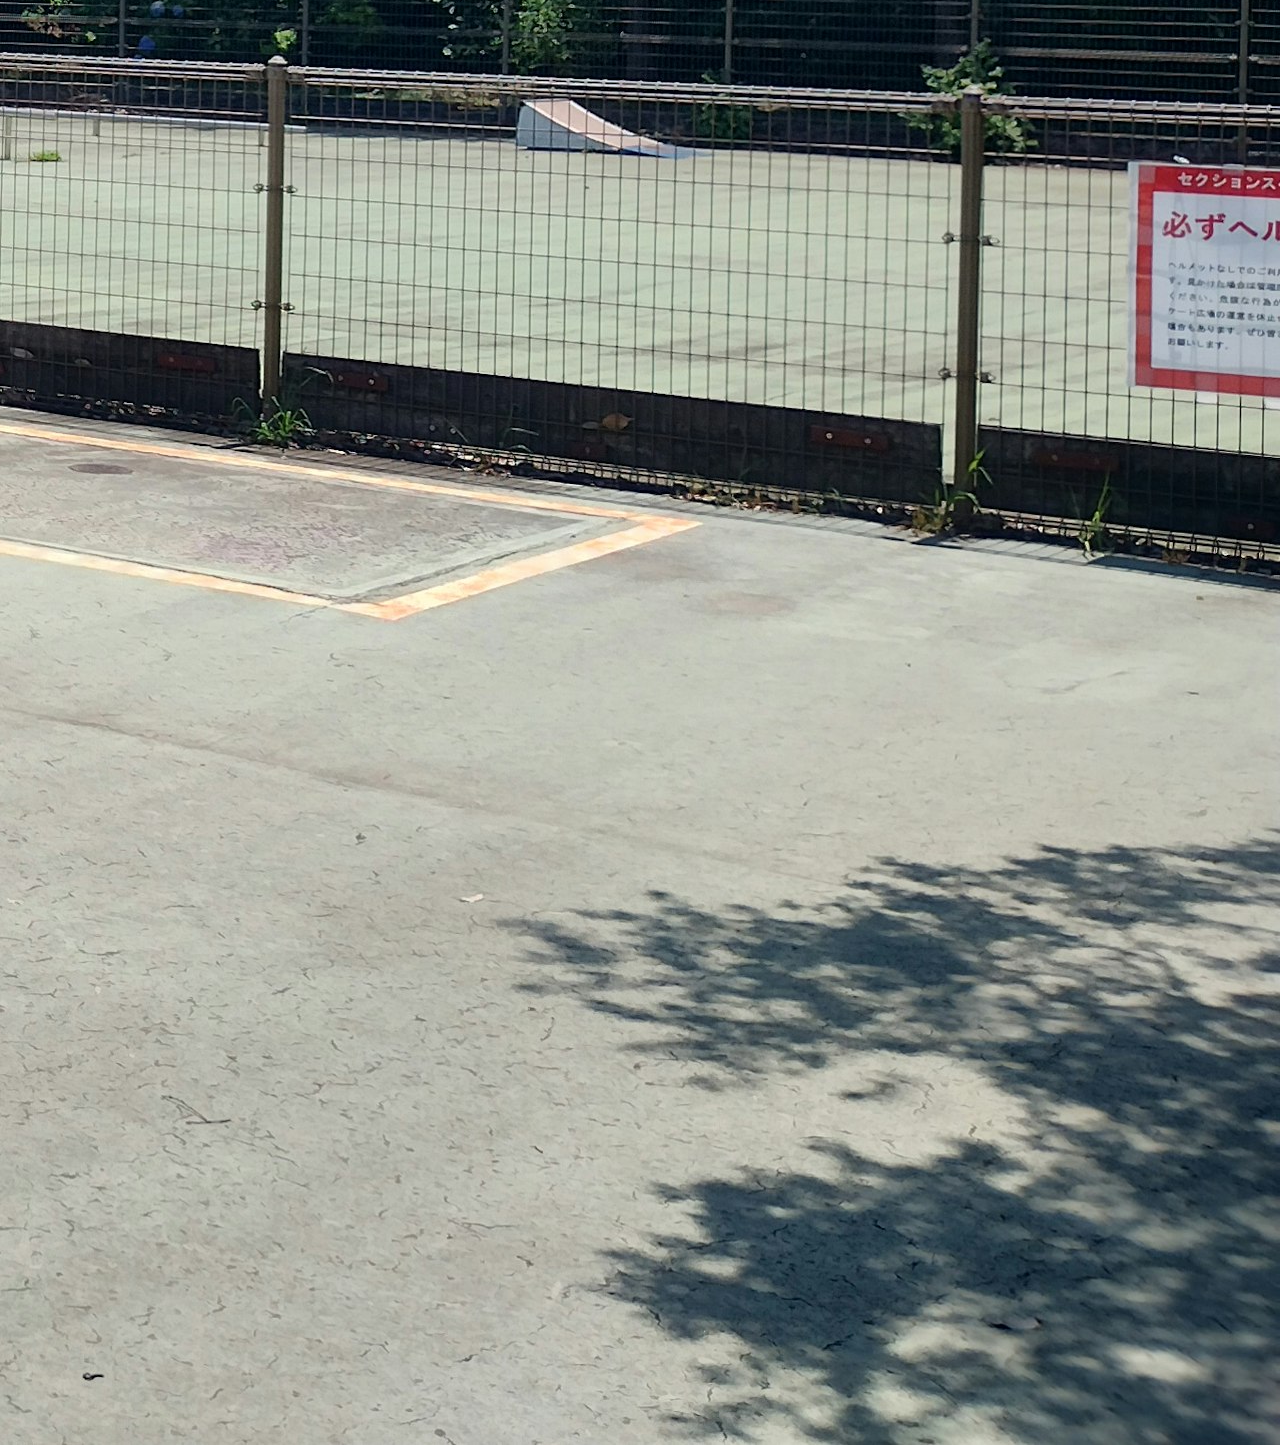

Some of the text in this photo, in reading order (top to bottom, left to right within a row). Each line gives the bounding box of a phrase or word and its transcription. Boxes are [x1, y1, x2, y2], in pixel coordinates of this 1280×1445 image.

[1177, 171, 1280, 190] セクションス
[1168, 307, 1280, 322] ケート広場の運営を休止
